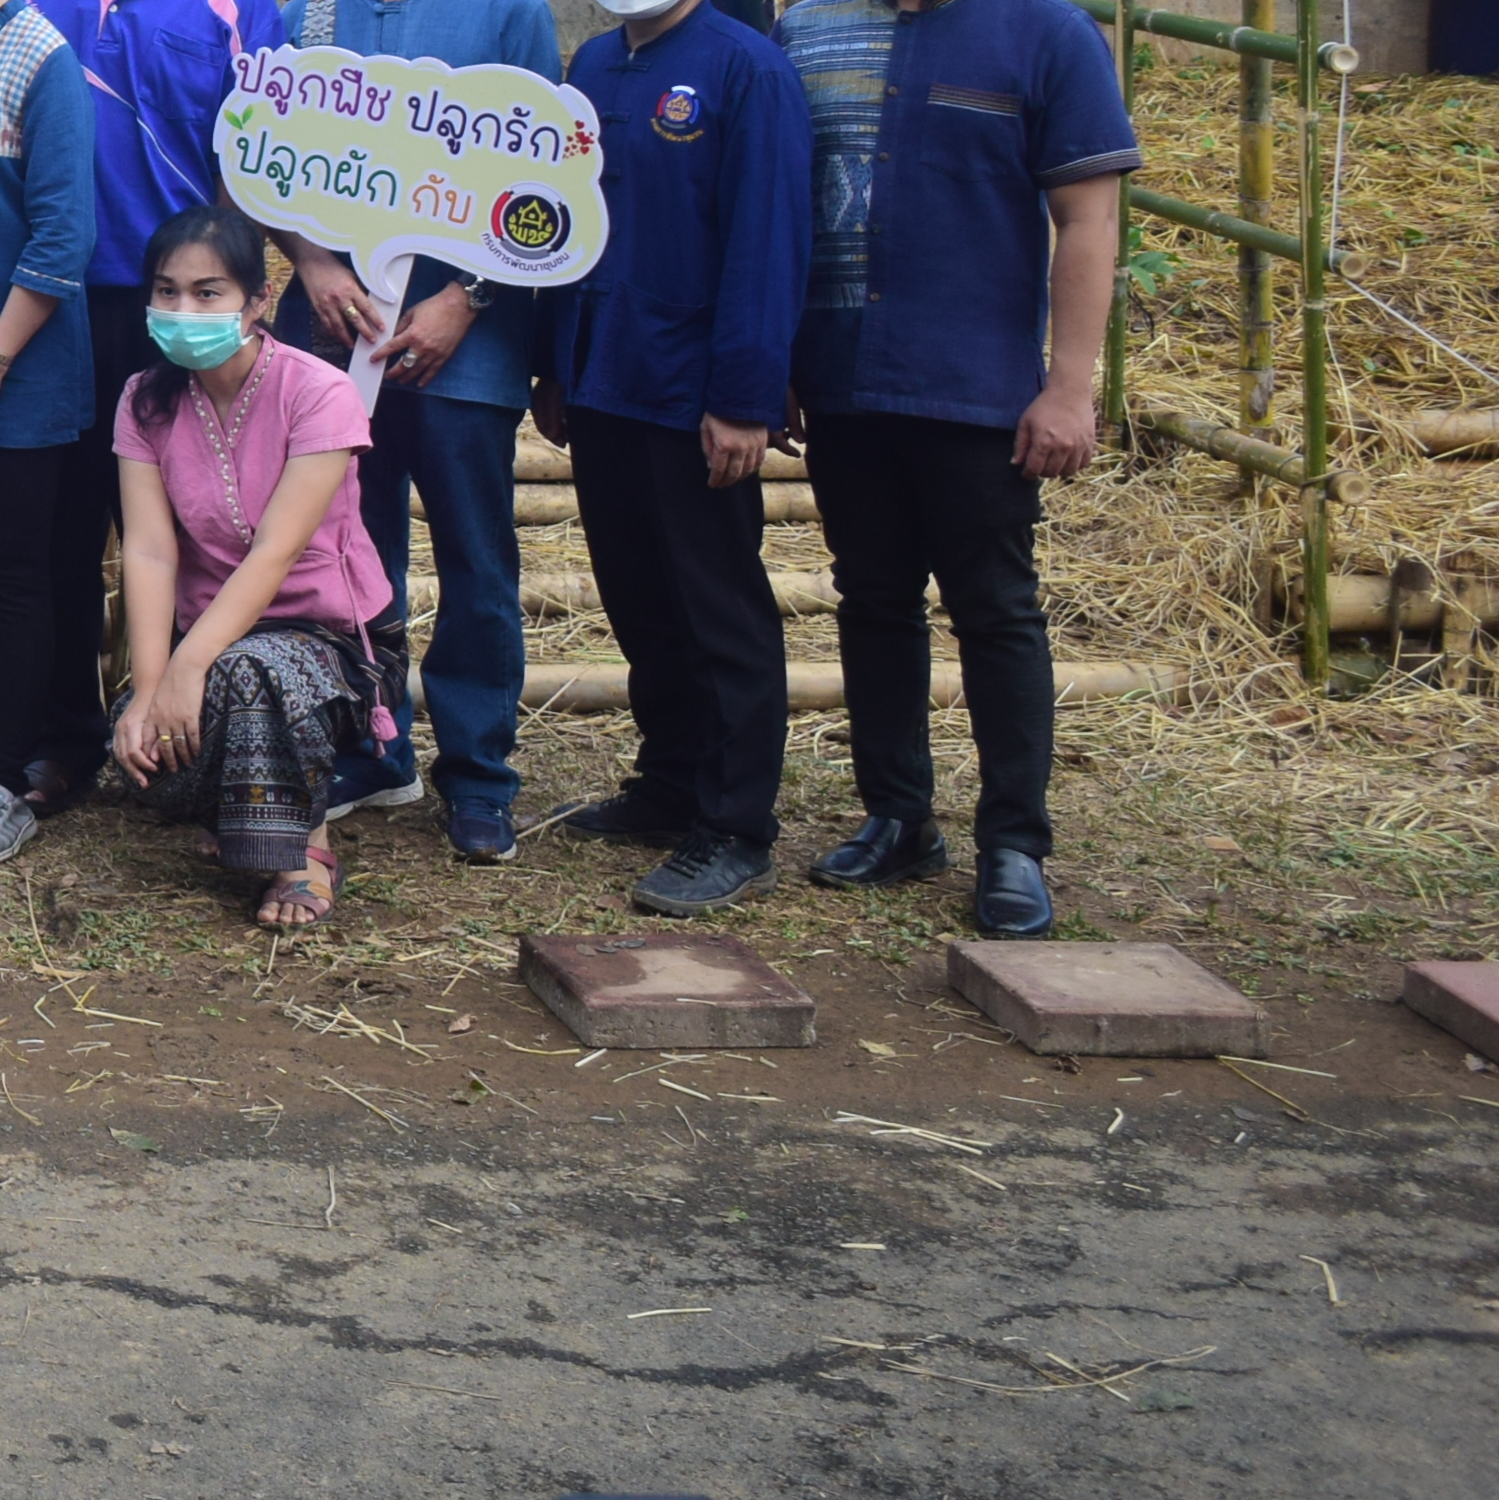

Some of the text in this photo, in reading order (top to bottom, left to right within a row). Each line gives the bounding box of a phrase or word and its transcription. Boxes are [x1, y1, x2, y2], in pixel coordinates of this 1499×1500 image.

[236, 52, 561, 162] ปลูกพืช ปลูกรัก
[236, 130, 473, 225] ปลูกผัก กับ
[482, 232, 570, 272] กรมการพัฒนาชุมชน
